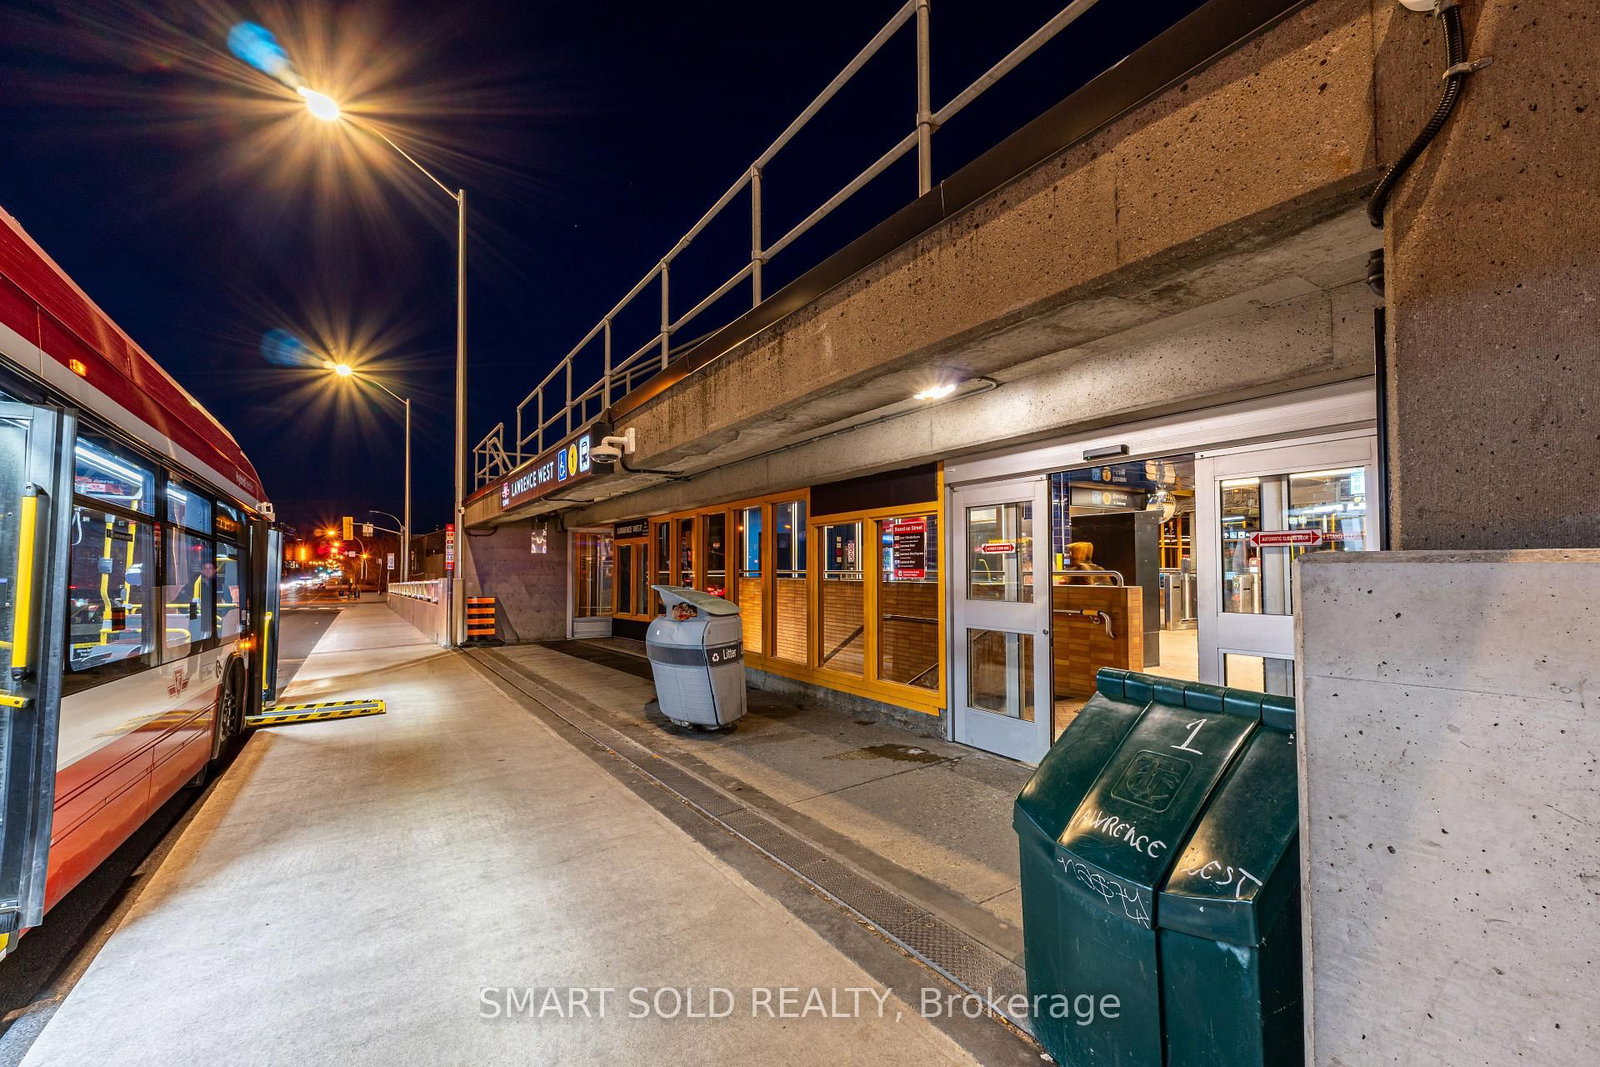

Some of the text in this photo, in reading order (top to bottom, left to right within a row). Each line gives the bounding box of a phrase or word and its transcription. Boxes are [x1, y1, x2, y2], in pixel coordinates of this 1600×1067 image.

[511, 471, 537, 497] LAWRENCE
[538, 462, 554, 484] WEST
[723, 648, 737, 660] Litter
[1170, 719, 1207, 755] 1
